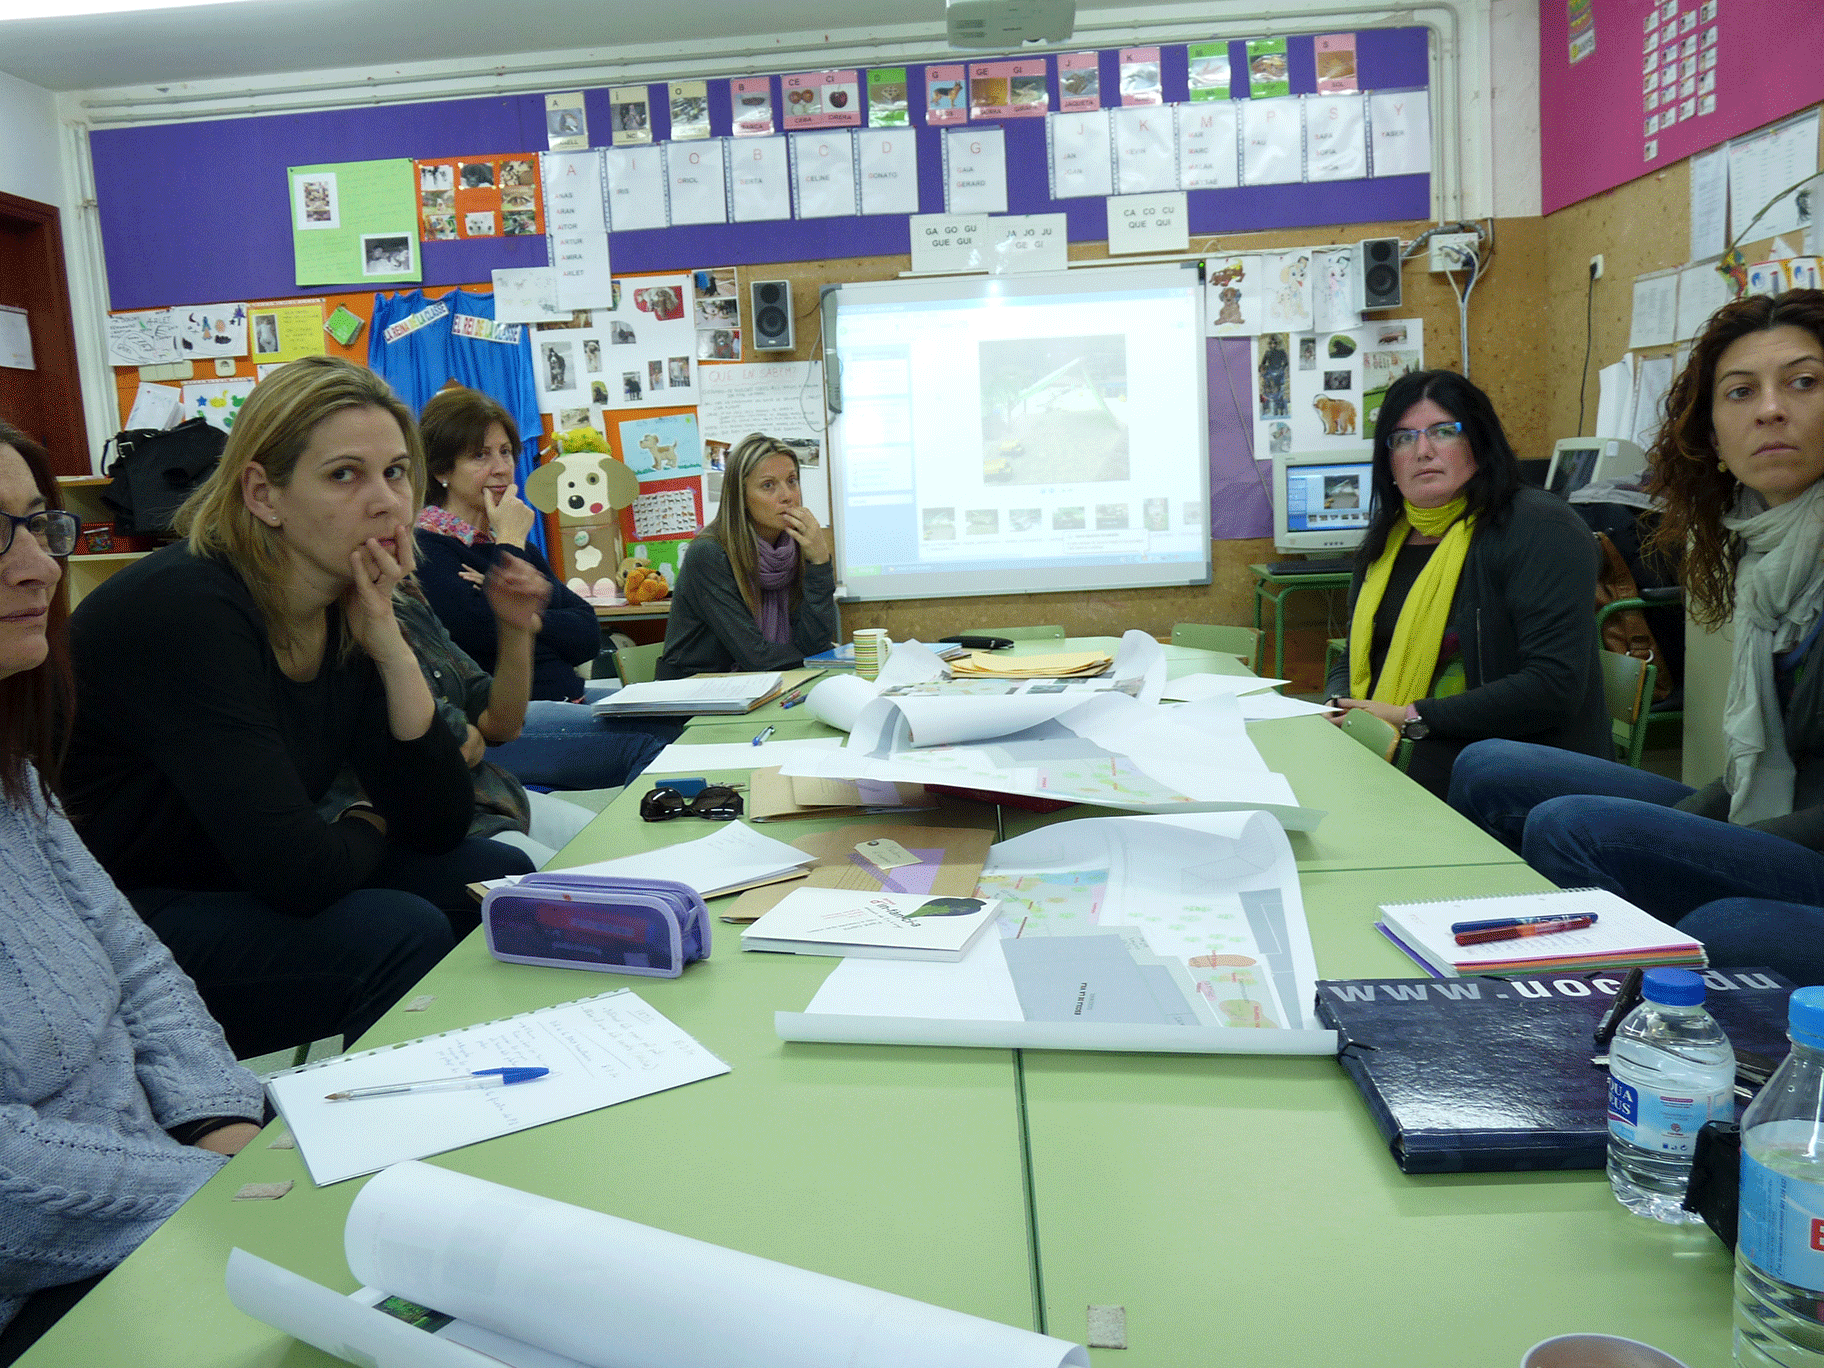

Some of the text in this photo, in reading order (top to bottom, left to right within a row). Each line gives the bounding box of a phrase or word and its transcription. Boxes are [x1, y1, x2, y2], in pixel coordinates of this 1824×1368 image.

[976, 68, 989, 76] GE
[1013, 66, 1022, 74] GI
[788, 78, 800, 86] CE
[825, 75, 835, 83] CI
[674, 87, 682, 95] O
[1064, 100, 1094, 108] JAQUETA
[1393, 103, 1404, 116] Y
[1266, 111, 1276, 122] P
[1329, 107, 1338, 120] S
[1139, 120, 1150, 131] K
[1201, 117, 1213, 128] M
[1077, 125, 1085, 136] J
[818, 144, 829, 156] C
[882, 141, 892, 154] D
[970, 142, 981, 154] G
[688, 152, 700, 165] O
[753, 148, 763, 160] B
[1063, 152, 1077, 160] JAN
[566, 164, 576, 176] A
[805, 174, 830, 182] CELINE
[957, 180, 986, 188] GERARD
[1124, 206, 1174, 216] CA CO CU
[1128, 218, 1171, 229] QUE QUI
[925, 225, 977, 236] GA GO GU
[1006, 227, 1052, 238] JA JO JU
[931, 237, 972, 247] GUE GUI
[1015, 240, 1043, 249] GE GI
[423, 301, 447, 321] CLASSE
[1327, 973, 1782, 1002] www.uocdu
